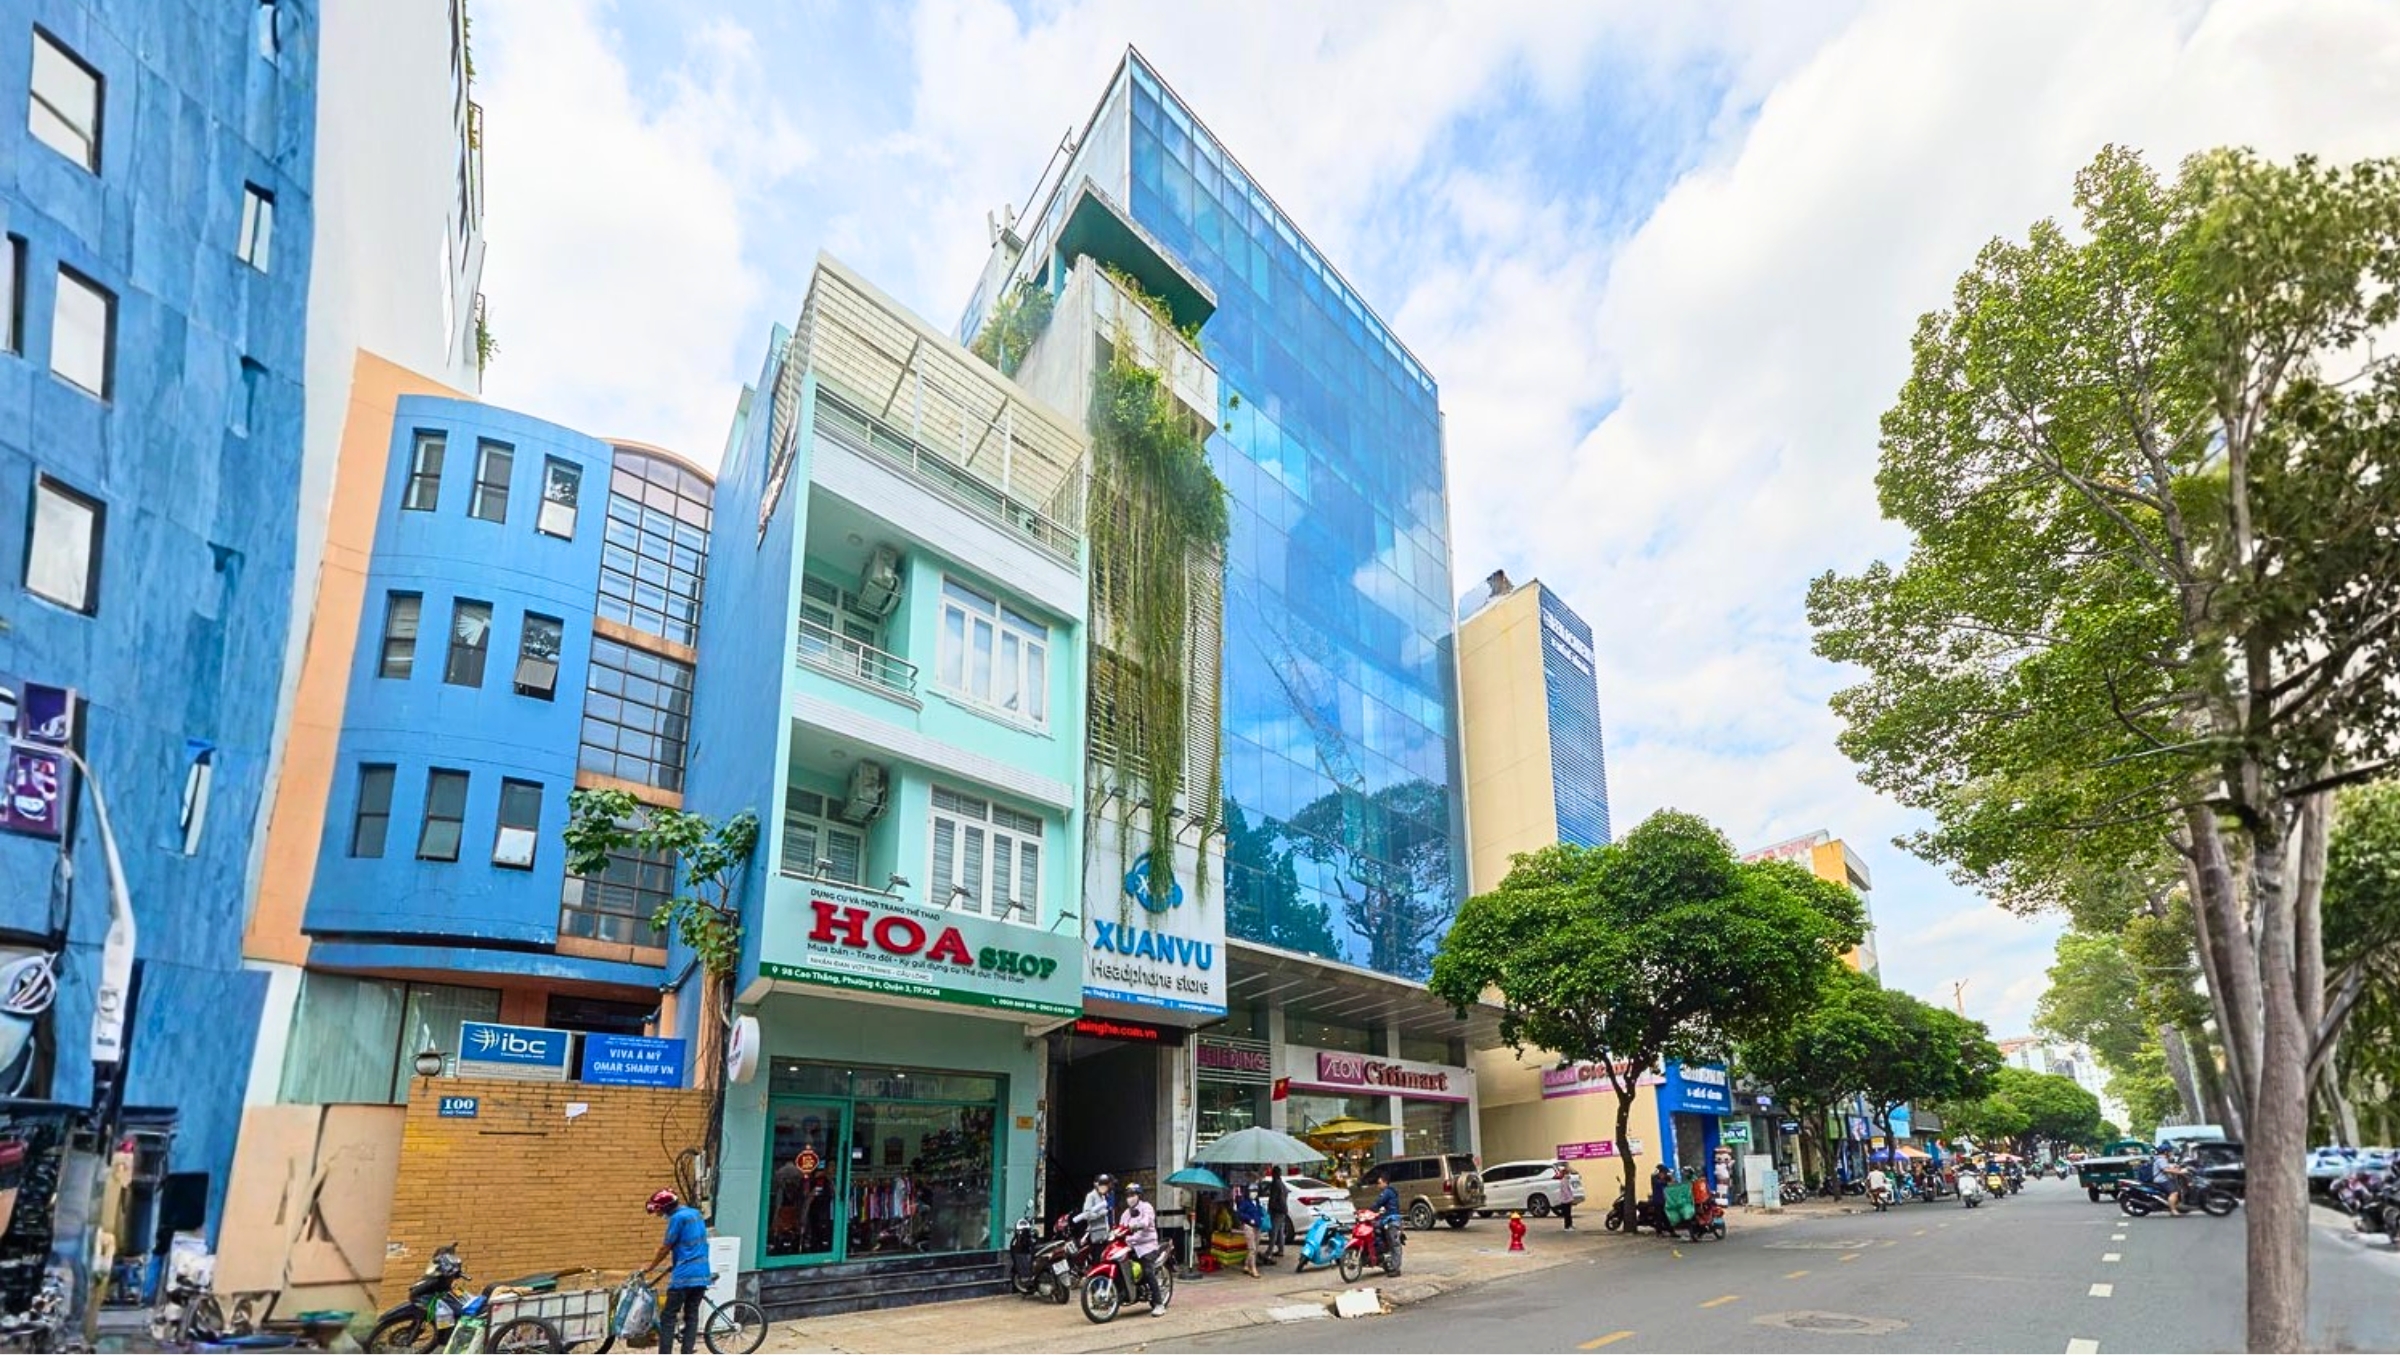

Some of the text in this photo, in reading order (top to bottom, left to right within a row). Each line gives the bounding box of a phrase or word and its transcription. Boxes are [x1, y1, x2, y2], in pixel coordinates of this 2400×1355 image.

[811, 888, 836, 900] DỤNG
[880, 902, 905, 914] TRANG
[920, 910, 940, 921] THAO
[808, 899, 1058, 980] HOA SHOP
[1093, 918, 1213, 971] XUANVU
[807, 942, 828, 953] Mua
[829, 945, 849, 956] bán
[857, 950, 876, 961] Trao
[781, 966, 793, 977] 98
[794, 968, 811, 979] Cao
[1091, 957, 1210, 995] Headphone store
[502, 1032, 548, 1055] ibc
[609, 1048, 634, 1060] VIVA
[593, 1061, 674, 1076] OMAR SHARIF VN
[1364, 1061, 1448, 1092] Citimart
[444, 1098, 475, 1110] 100
